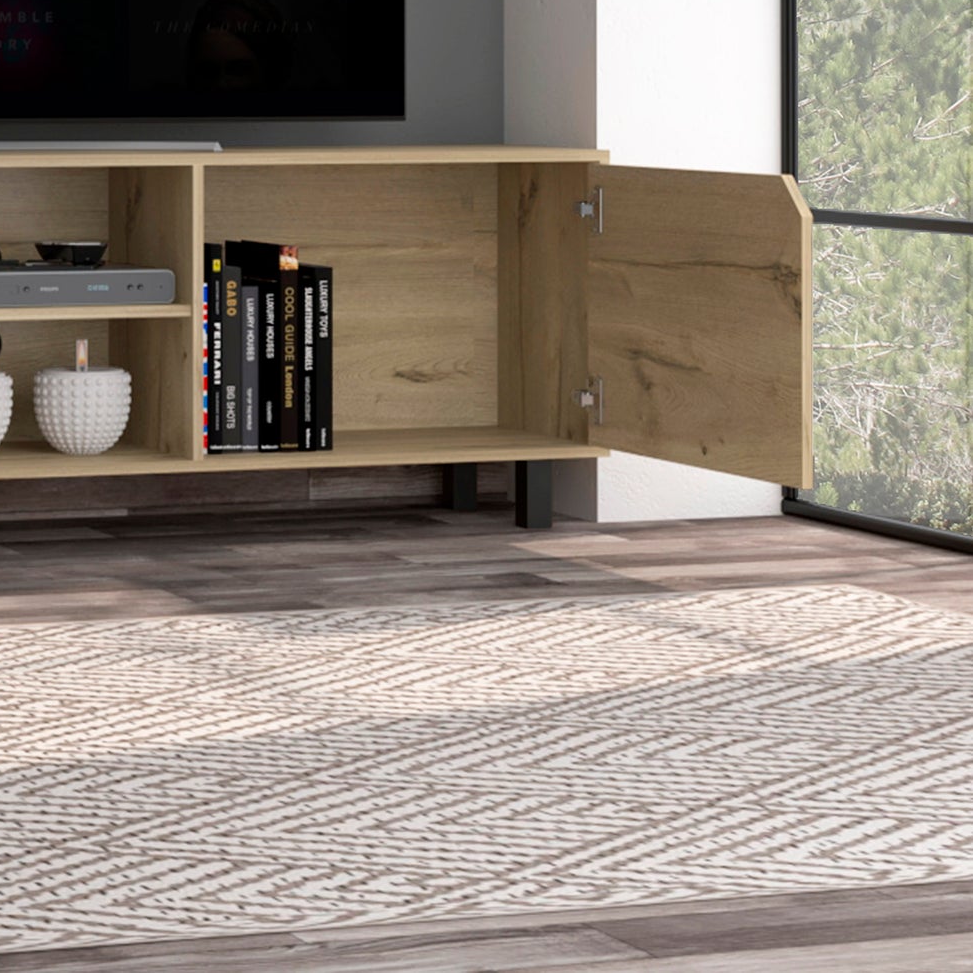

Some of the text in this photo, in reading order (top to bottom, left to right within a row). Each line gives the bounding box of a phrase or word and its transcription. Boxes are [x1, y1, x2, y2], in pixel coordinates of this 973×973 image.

[226, 280, 237, 316] GABO
[266, 293, 275, 359] LUXURY HOUSES
[319, 280, 328, 338] LUXURY TOYS
[213, 322, 221, 385] FERRARI
[246, 297, 255, 362] LUXURY HOUSES
[285, 287, 295, 408] COOL GUIDE London
[304, 346, 313, 371] ANGELS
[226, 385, 236, 429] BIG SHOTS
